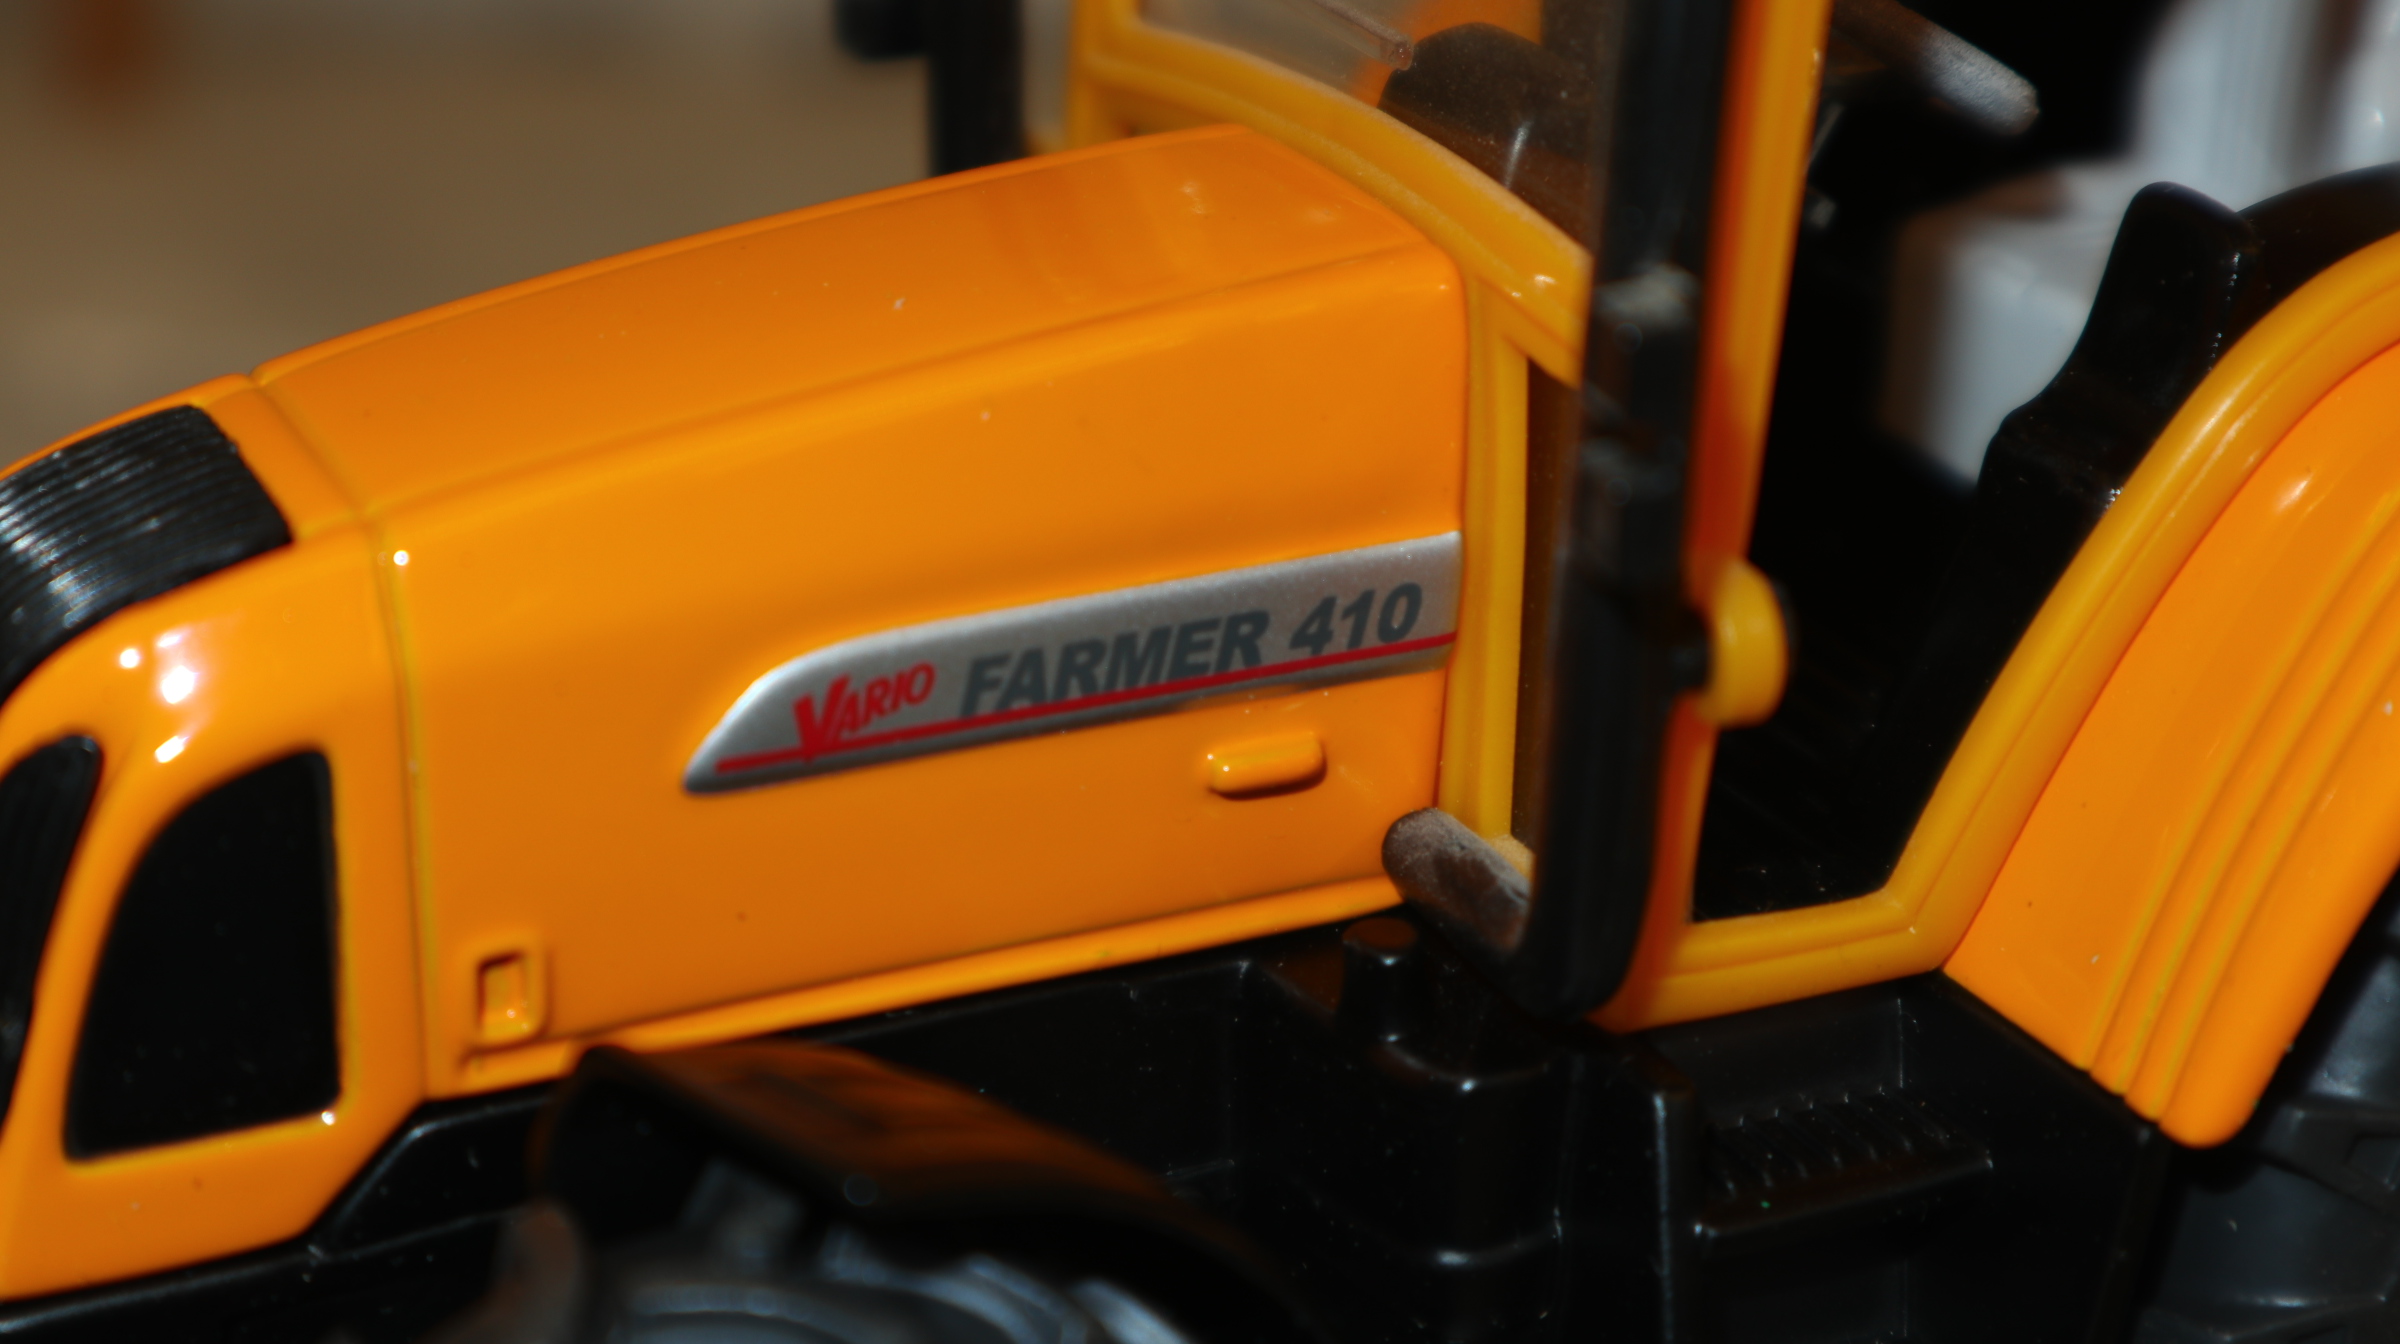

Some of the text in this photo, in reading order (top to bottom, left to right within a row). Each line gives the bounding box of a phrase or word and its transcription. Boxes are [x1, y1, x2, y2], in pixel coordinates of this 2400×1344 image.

[793, 582, 1423, 761] VARIO FARMER 410
